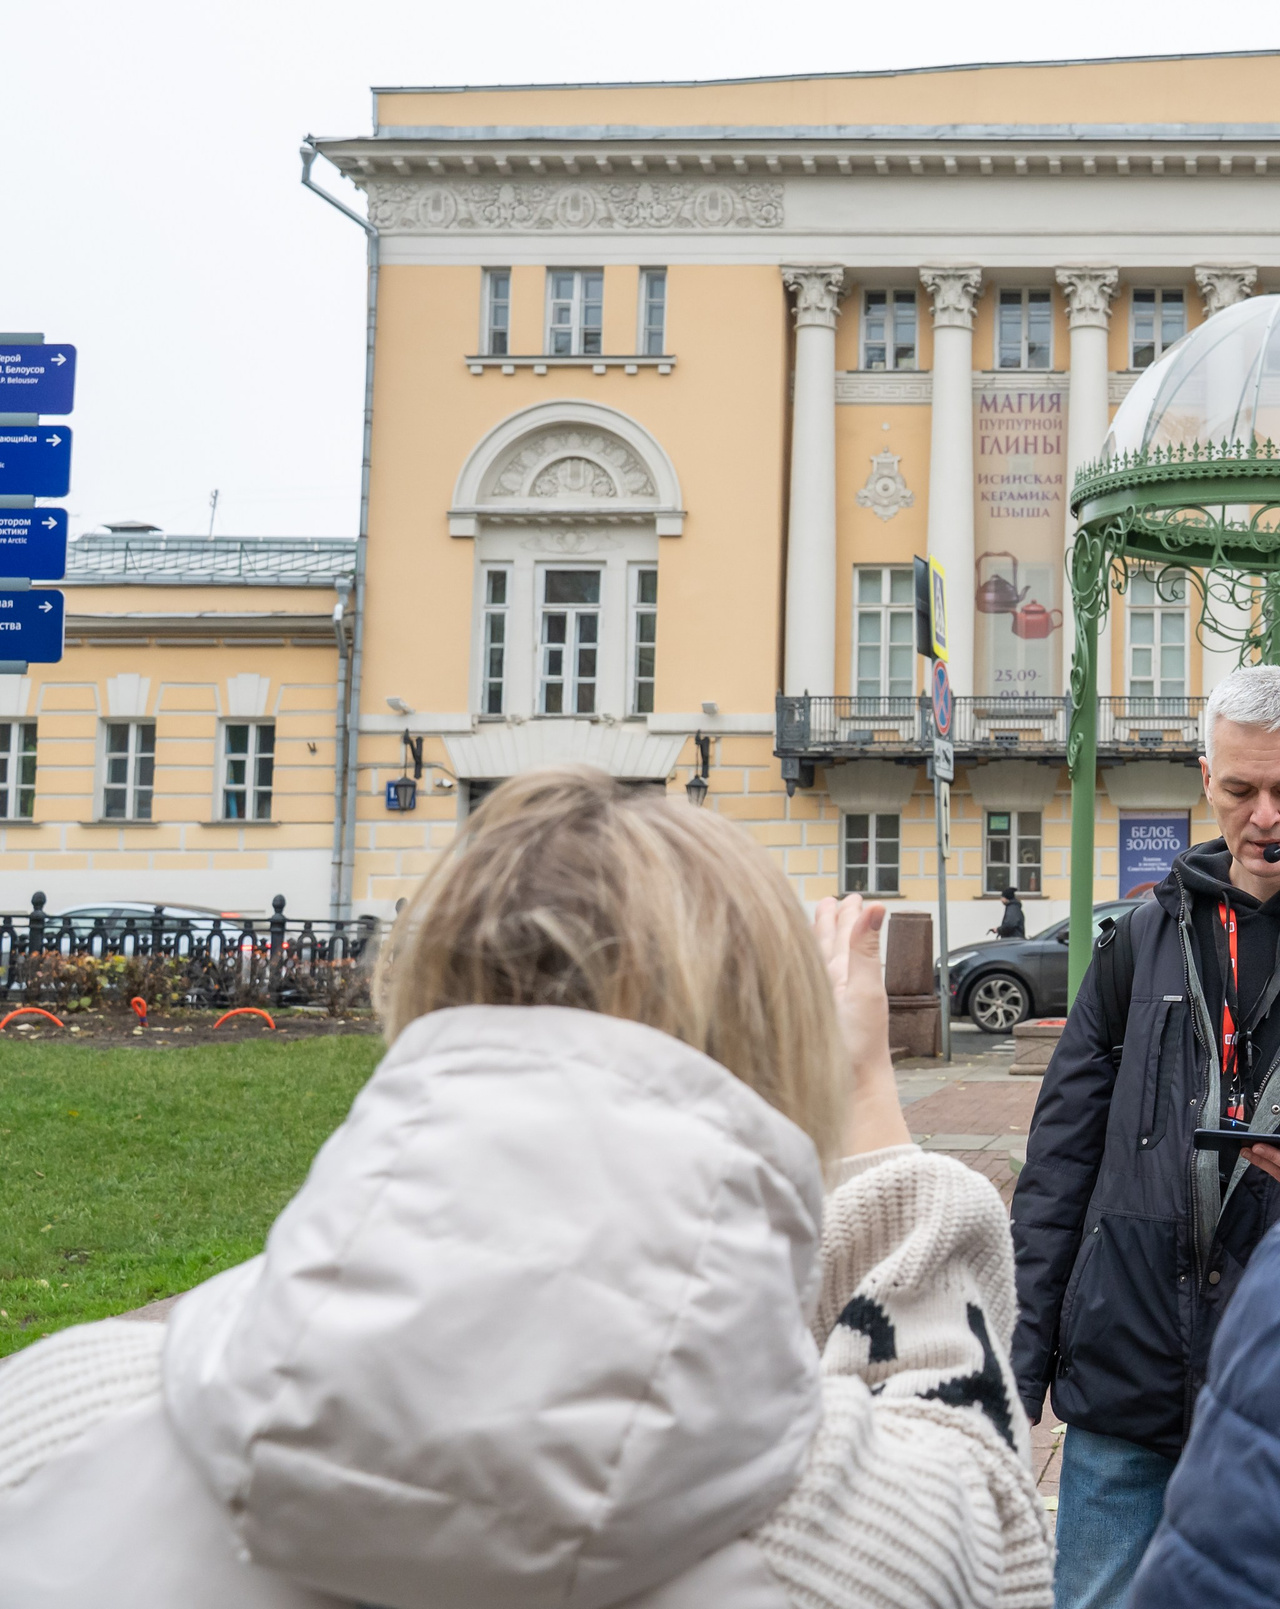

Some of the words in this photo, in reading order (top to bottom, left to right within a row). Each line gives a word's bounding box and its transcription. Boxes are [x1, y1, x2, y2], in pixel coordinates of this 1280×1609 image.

[0, 354, 21, 364] ерой
[6, 365, 45, 376] Белоусов
[980, 392, 1061, 414] МАГИЯ
[979, 415, 1063, 431] ПУРПУРНОЙ
[980, 435, 1062, 455] ГЛИНЫ
[977, 473, 1064, 485] ИСИНСКАЯ
[981, 491, 1061, 502] КЕРАМИКА
[990, 505, 1050, 518] ЦЗЫША
[1131, 825, 1175, 838] БЕЛОЕ
[1126, 838, 1181, 851] ЗОЛОТО
